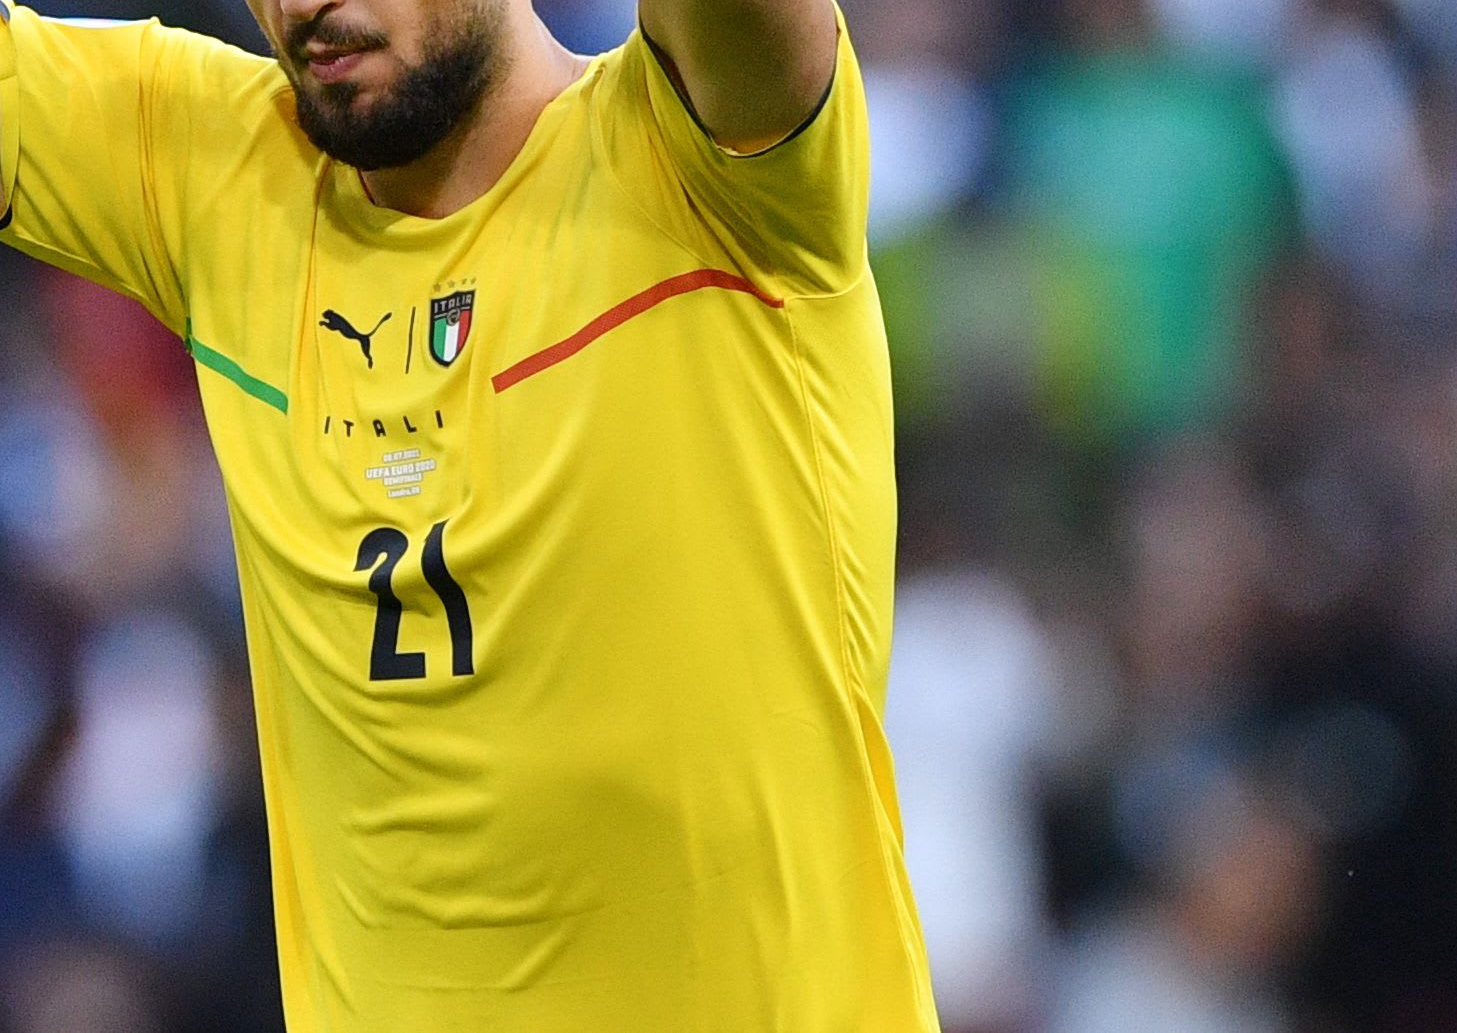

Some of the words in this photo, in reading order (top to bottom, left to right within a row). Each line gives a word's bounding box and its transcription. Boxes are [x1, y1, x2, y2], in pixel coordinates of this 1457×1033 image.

[433, 293, 473, 314] ITALIA
[366, 467, 390, 479] UEFA
[390, 462, 415, 476] EURO
[351, 520, 475, 682] 21
